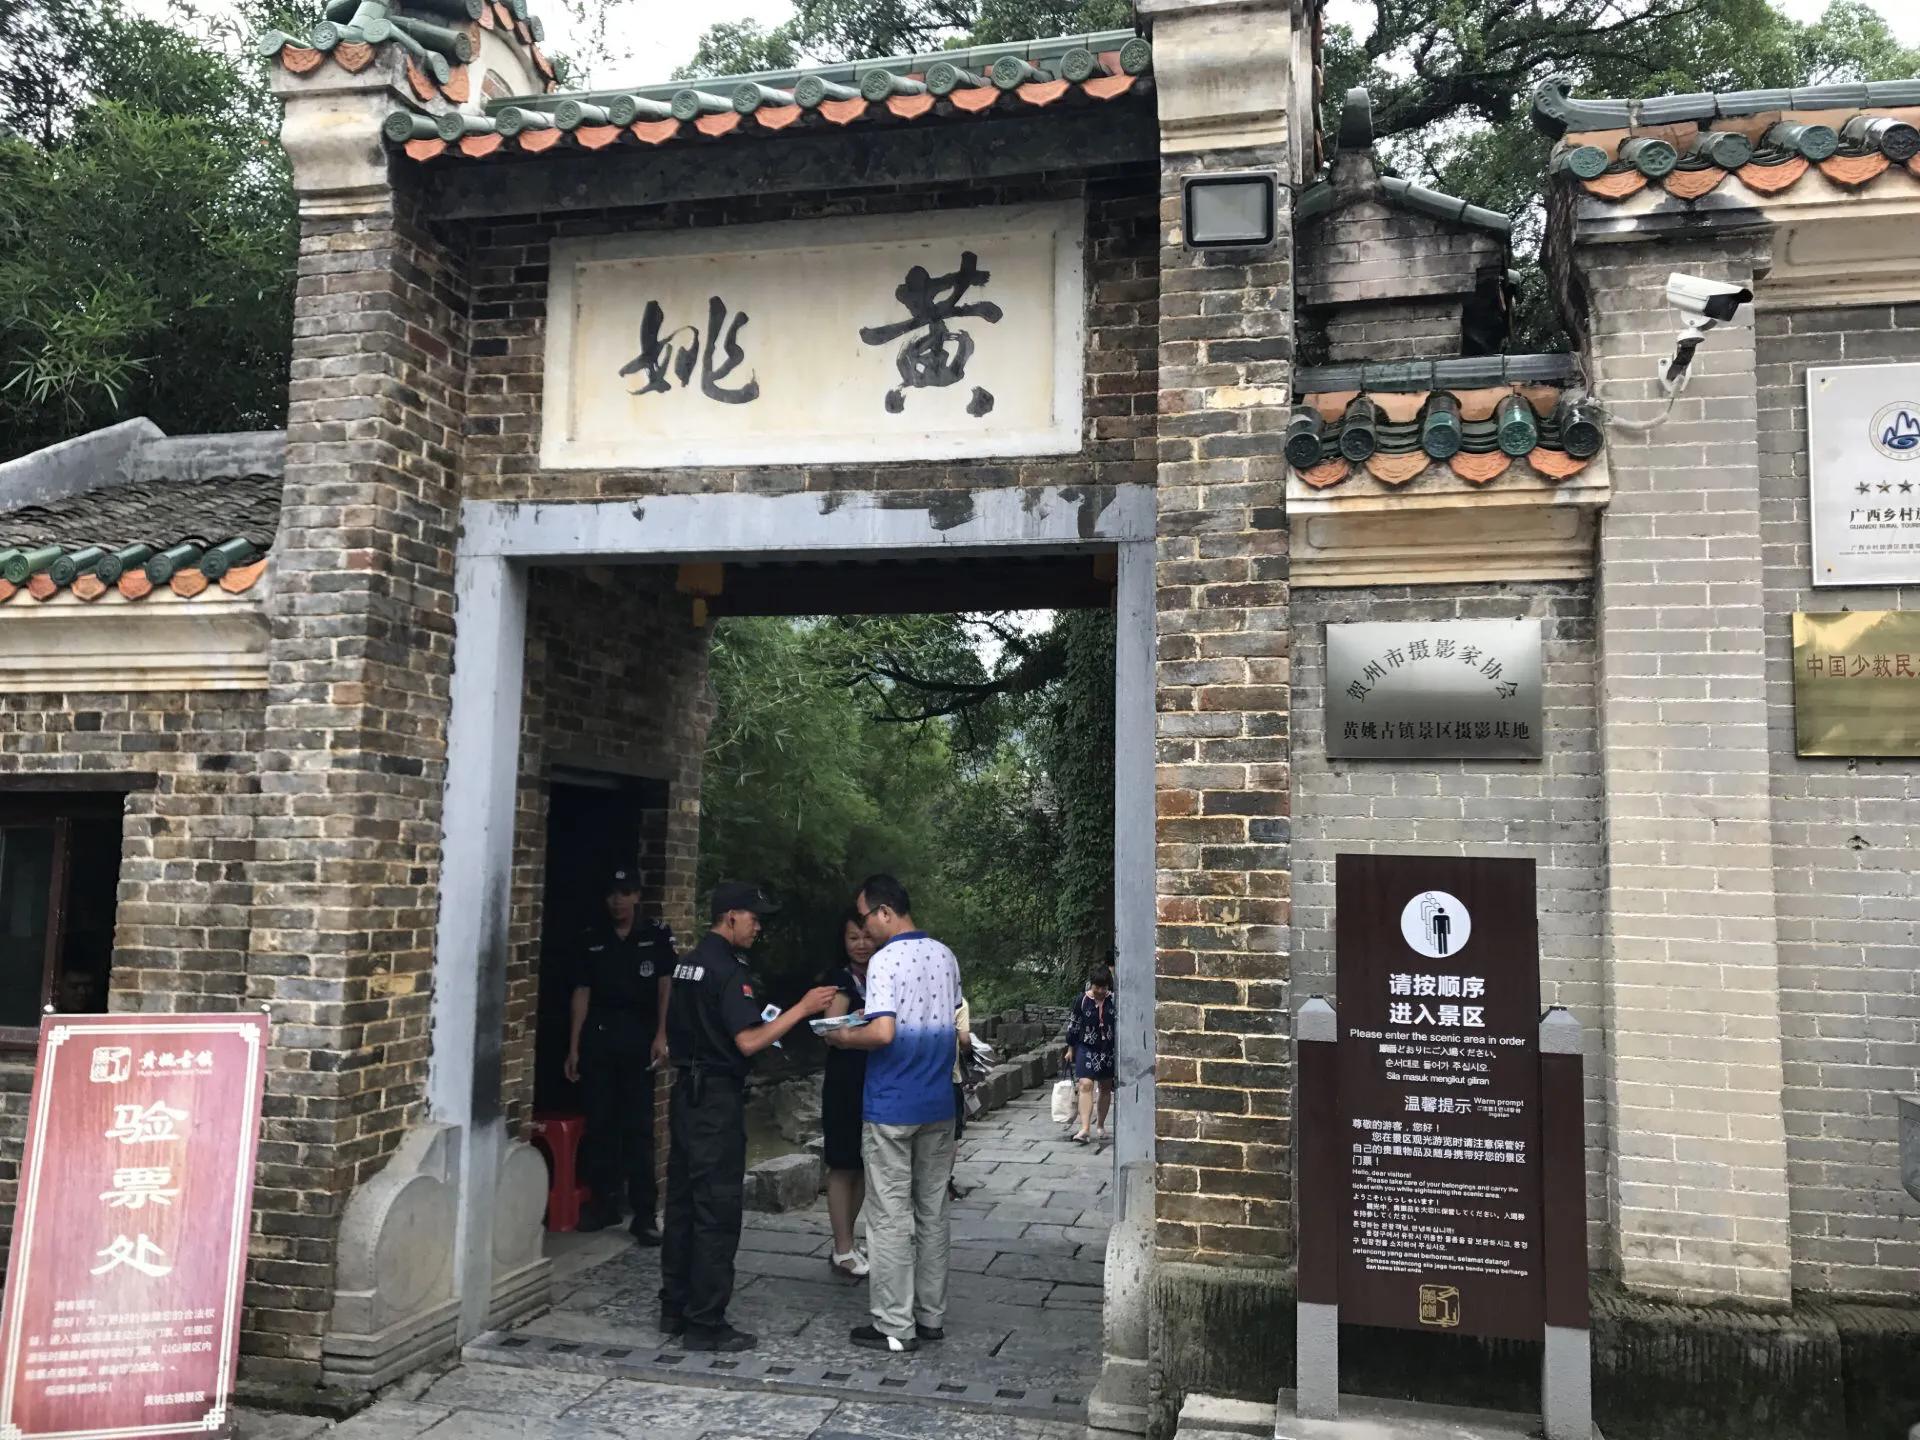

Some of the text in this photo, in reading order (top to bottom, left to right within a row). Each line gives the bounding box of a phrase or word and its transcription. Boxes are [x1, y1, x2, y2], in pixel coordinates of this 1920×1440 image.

[1346, 638, 1519, 703] 贺州市摄影家协会
[1806, 653, 1920, 678] 中国少数民
[1343, 720, 1531, 740] 黄姚古镇景区摄影基地
[1389, 973, 1485, 998] 请按顺序
[1389, 1002, 1486, 1028] 进入景区
[1350, 1028, 1526, 1046] Please enter the scenic area in order
[1385, 1058, 1420, 1068] 순서대로
[1423, 1060, 1449, 1070] 들어가
[1403, 1073, 1429, 1082] masuk
[1430, 1075, 1465, 1085] mengikut
[1467, 1076, 1490, 1086] giliran
[1404, 1095, 1472, 1114] 温馨提示
[1473, 1096, 1496, 1105] Warm
[1372, 1131, 1526, 1151] 您在景区观光游览时请注意保管好
[1352, 1141, 1526, 1164] 自己的贵重物品及随身携带好您的景区
[89, 1099, 189, 1277] 验票处
[1366, 1176, 1388, 1184] Please
[1441, 1181, 1476, 1191] belongings
[1414, 1187, 1451, 1196] sightseeing
[1463, 1190, 1483, 1198] scenic
